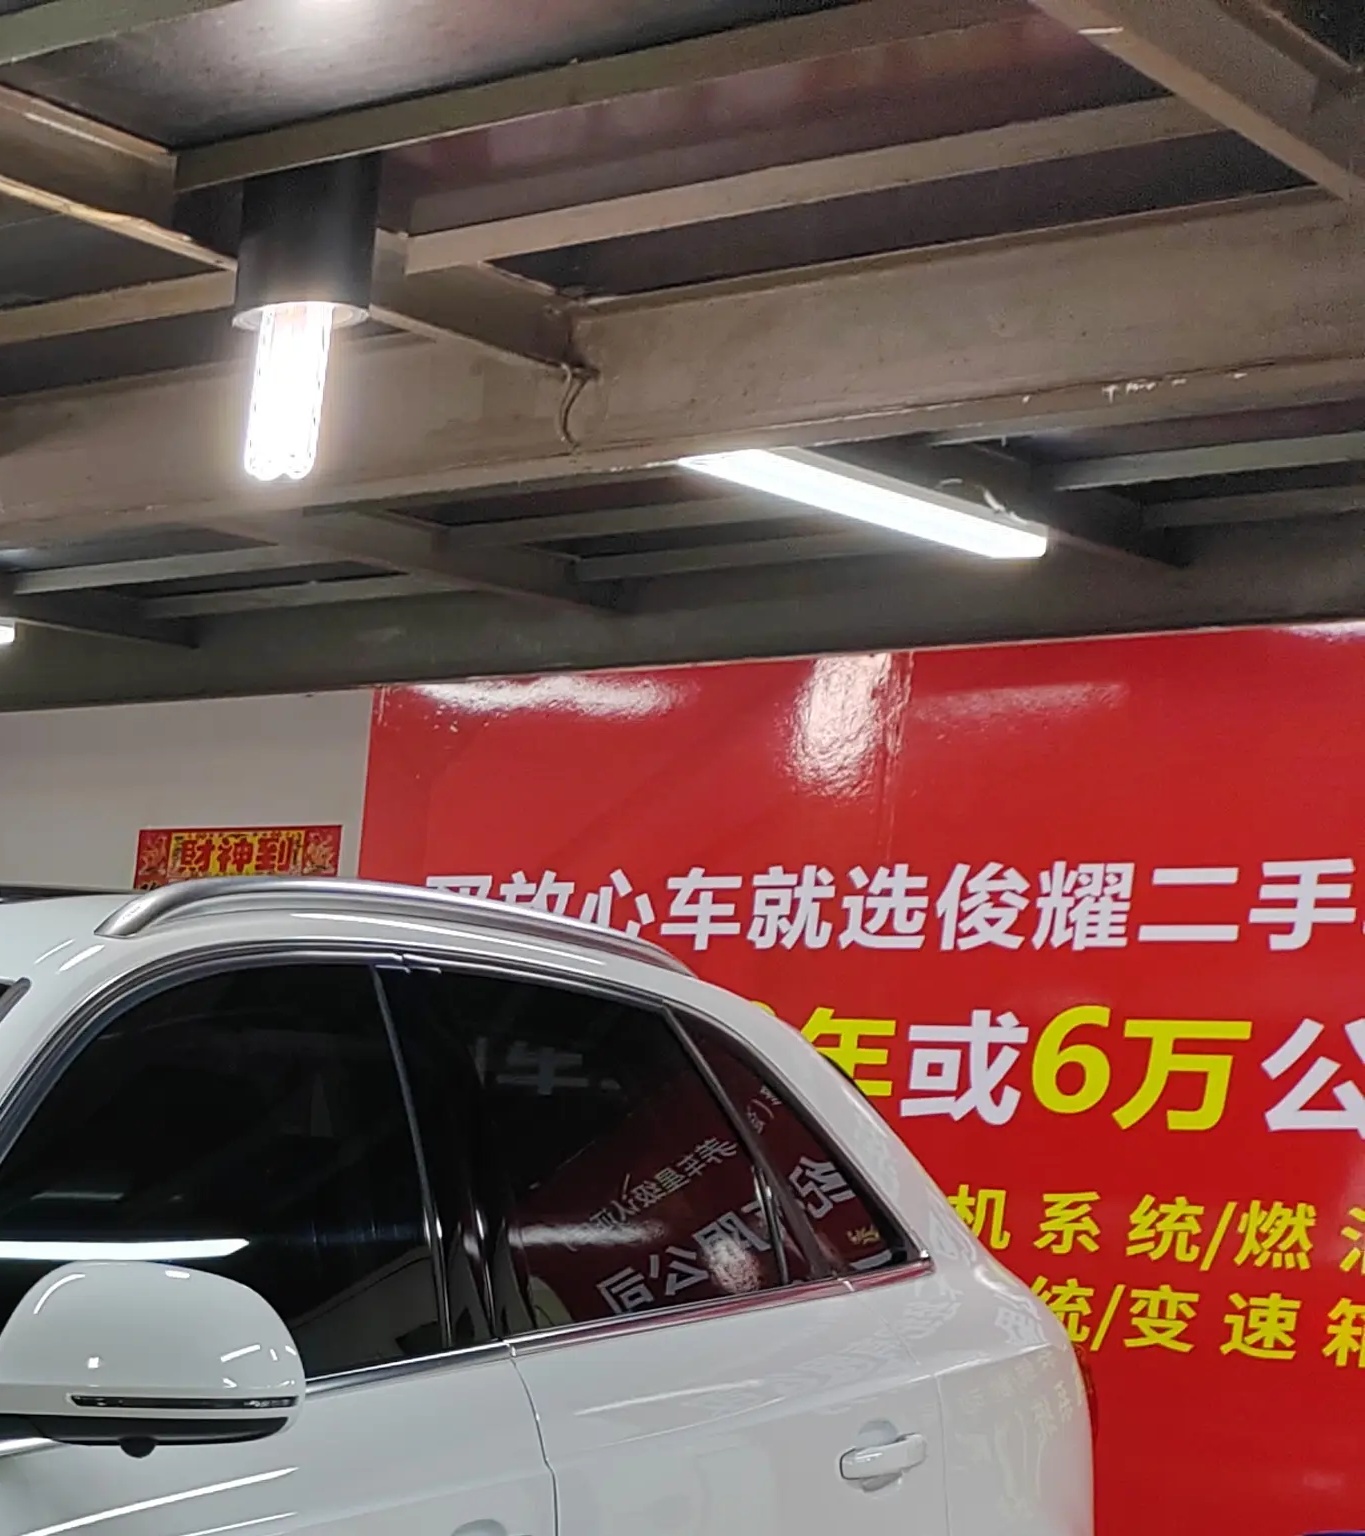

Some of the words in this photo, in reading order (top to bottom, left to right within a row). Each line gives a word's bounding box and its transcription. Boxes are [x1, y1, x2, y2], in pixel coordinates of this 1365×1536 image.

[426, 858, 1356, 952] 放心车就选俊耀二手
[750, 1000, 1365, 1140] 年或6万公
